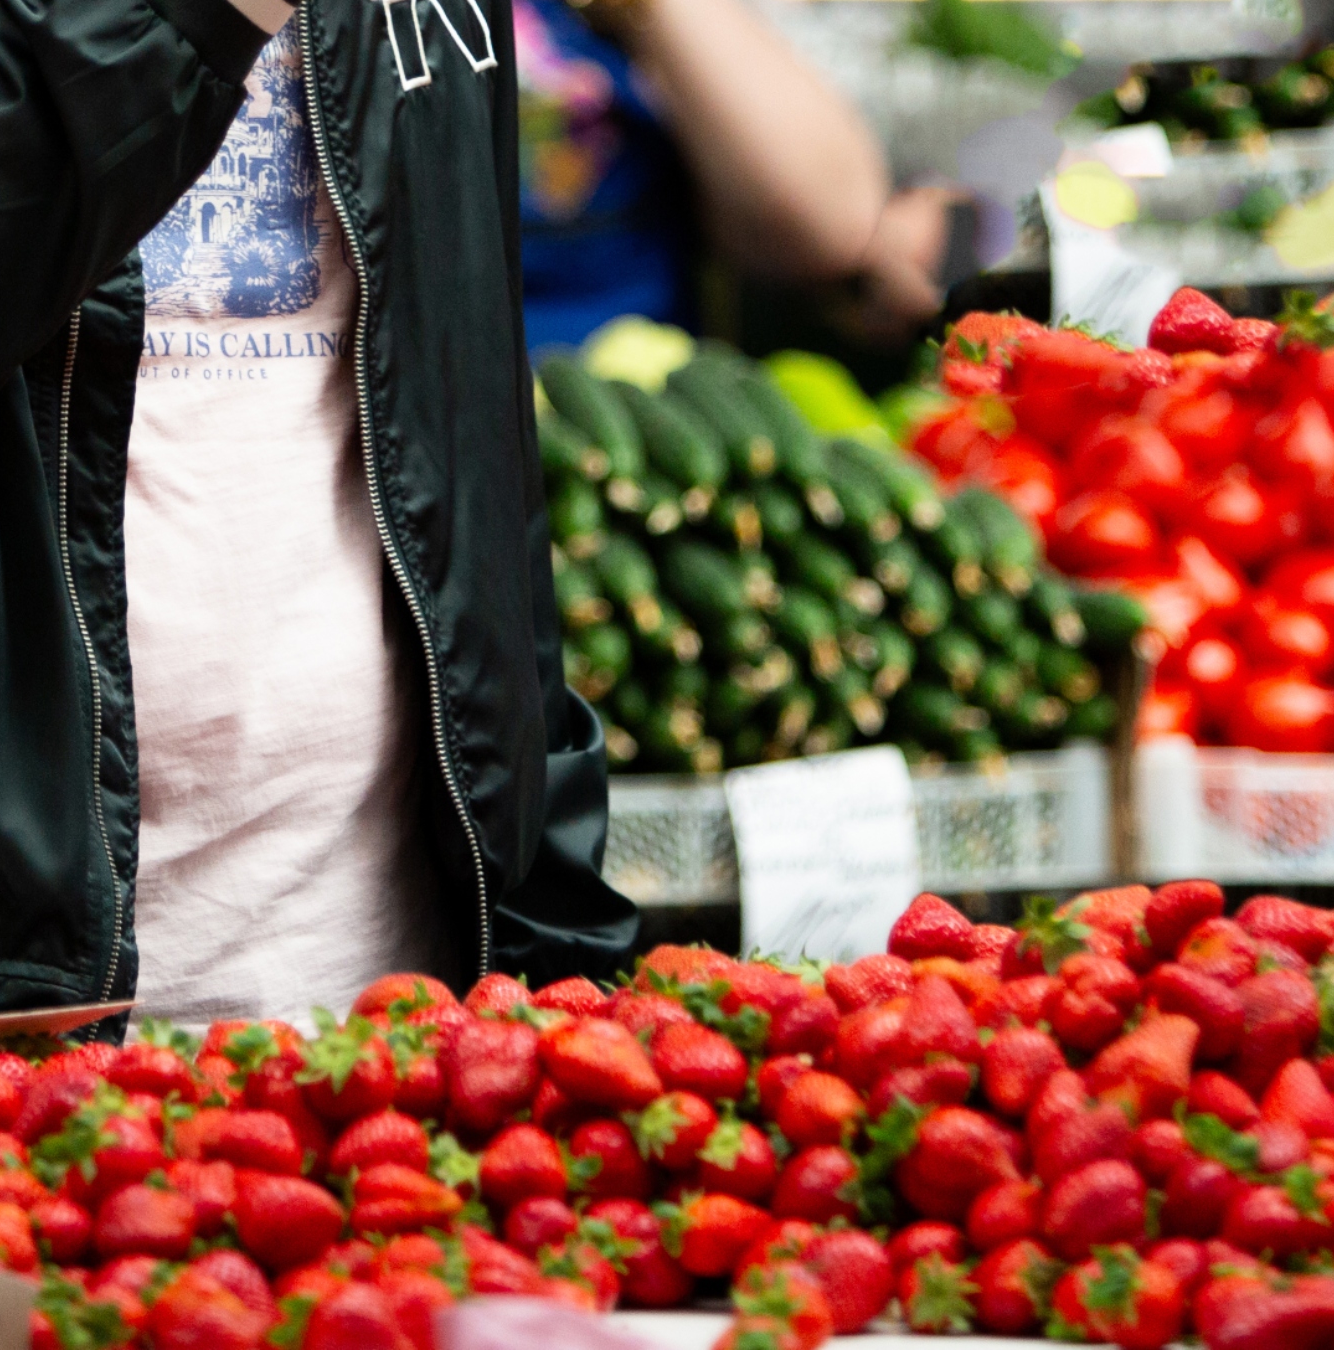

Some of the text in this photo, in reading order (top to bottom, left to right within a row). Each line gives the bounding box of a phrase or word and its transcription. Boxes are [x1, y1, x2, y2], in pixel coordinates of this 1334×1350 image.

[141, 331, 176, 357] AY
[184, 332, 211, 358] IS
[140, 366, 269, 380] UT OF OFFICE
